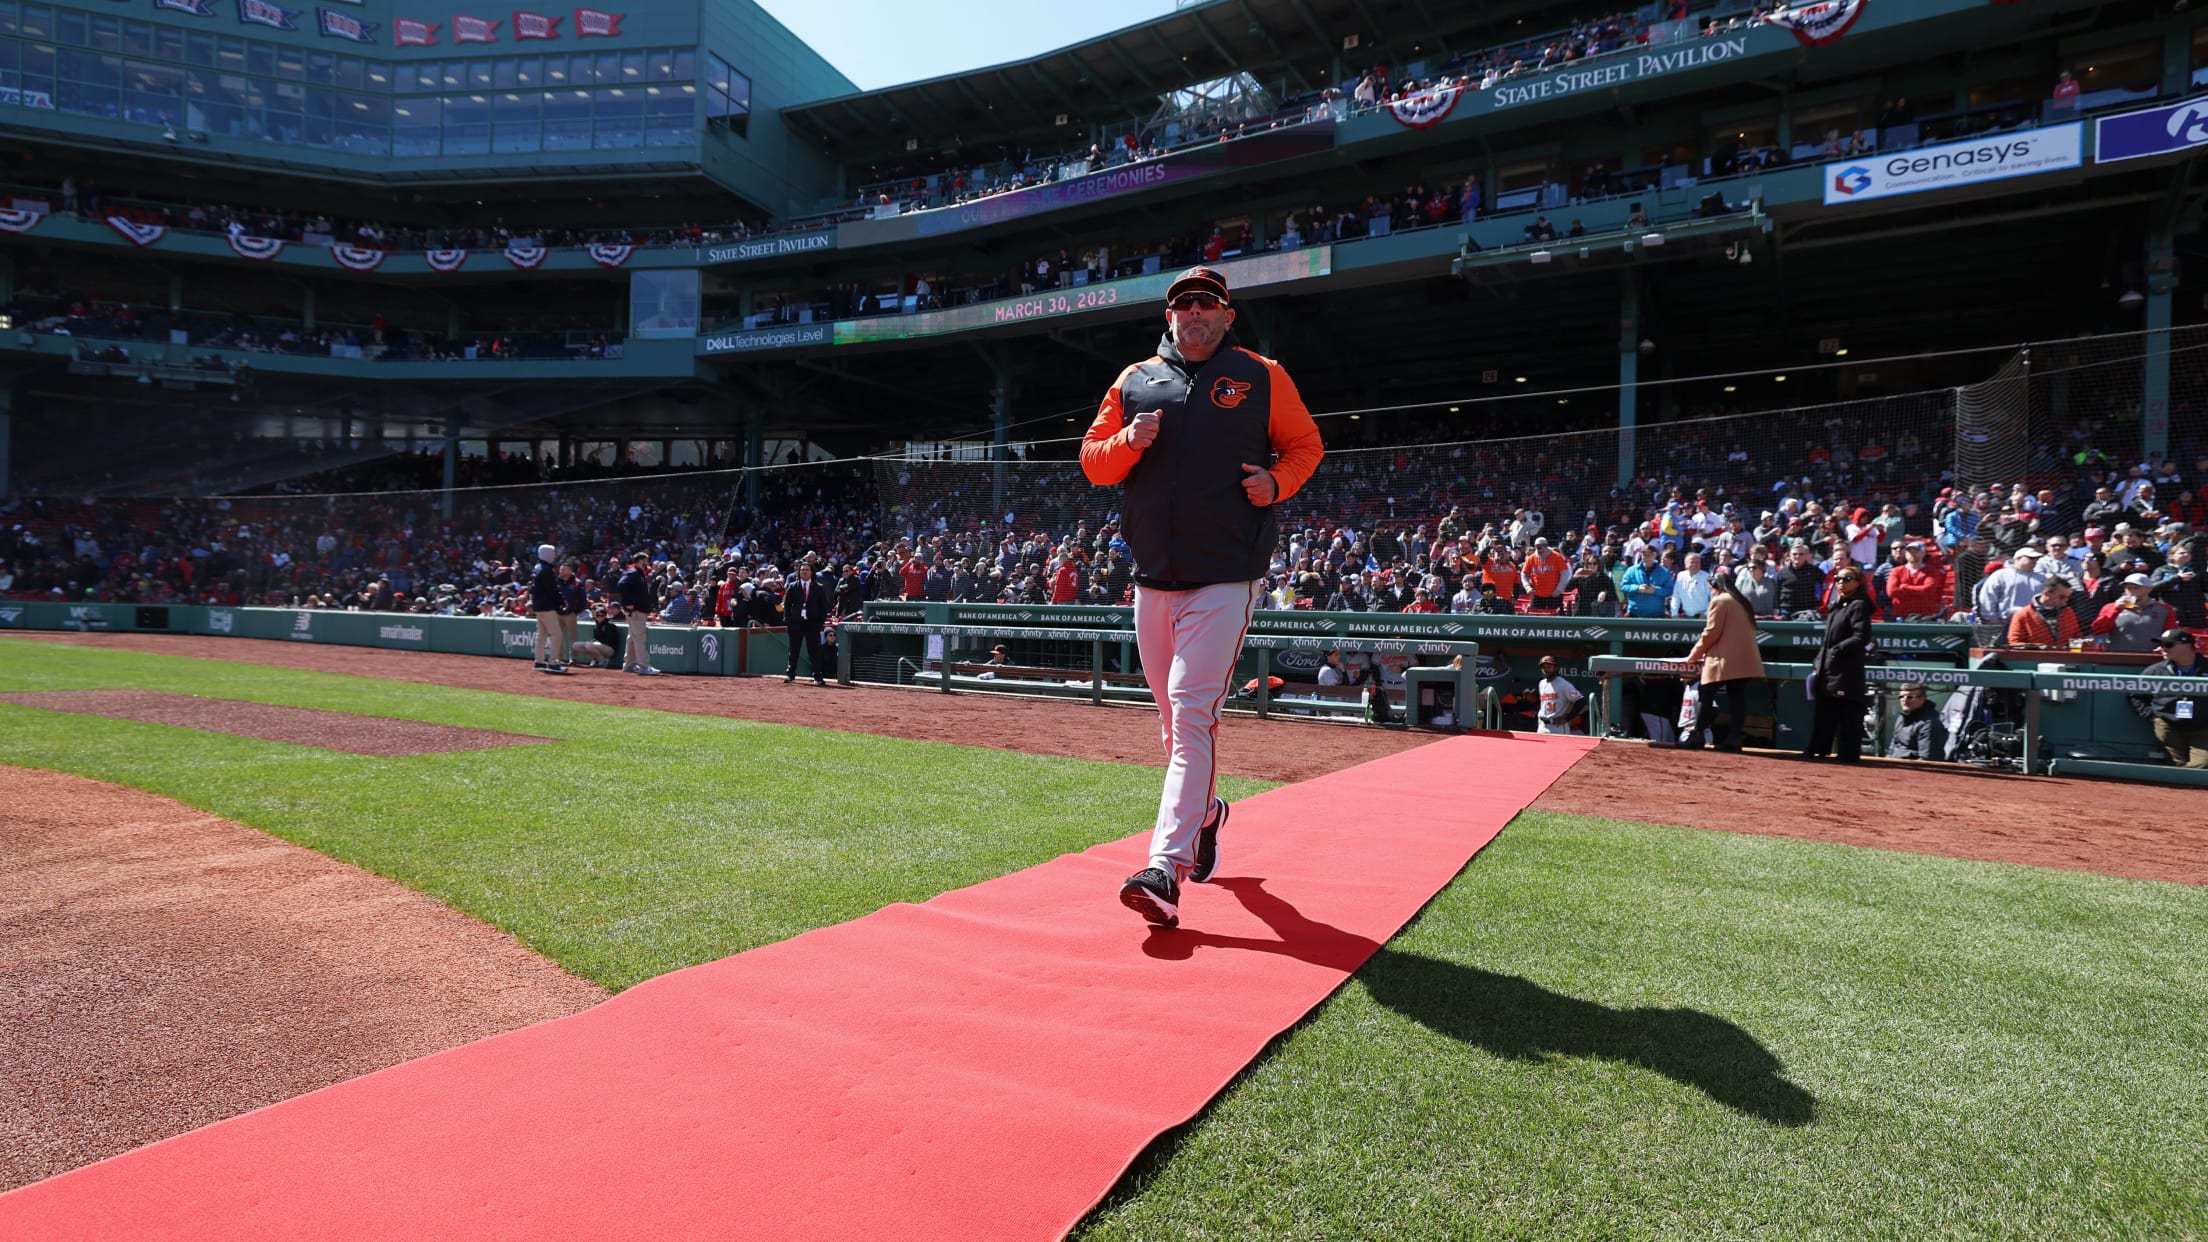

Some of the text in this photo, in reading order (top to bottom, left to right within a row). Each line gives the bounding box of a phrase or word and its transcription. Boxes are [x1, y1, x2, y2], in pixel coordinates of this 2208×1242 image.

[1494, 36, 1747, 108] STATE STREET PAVILION
[1886, 141, 2030, 176] Genasys
[1068, 163, 1165, 199] CEREMONIES
[709, 235, 829, 262] STATE STREET PAVILION
[995, 288, 1117, 321] MARCH 30, 2023
[707, 328, 823, 350] DELL Technologies Level
[1273, 621, 1315, 629] AMERICA
[1349, 623, 1440, 634] BANK OF AMERICA
[967, 628, 988, 636] xfinity
[993, 628, 1015, 637] xfinity
[1020, 629, 1043, 638] xfinity
[1048, 629, 1071, 639] xfinity
[1077, 630, 1101, 640] xfinity
[1109, 632, 1134, 642] xfinity
[1478, 627, 1581, 638] BANK OF AMERICA
[1624, 631, 1660, 640] BANK
[1662, 632, 1680, 641] OF
[1248, 638, 1277, 648] xfinity
[1292, 638, 1322, 648] xfinity
[1332, 639, 1363, 649] xfinity
[1792, 636, 1822, 645] BAN
[649, 644, 684, 655] LifeBrand
[1374, 641, 1406, 652] xfinity
[1418, 641, 1452, 653] xfinity
[1286, 651, 1321, 667] Ford
[1546, 702, 1557, 712] 31
